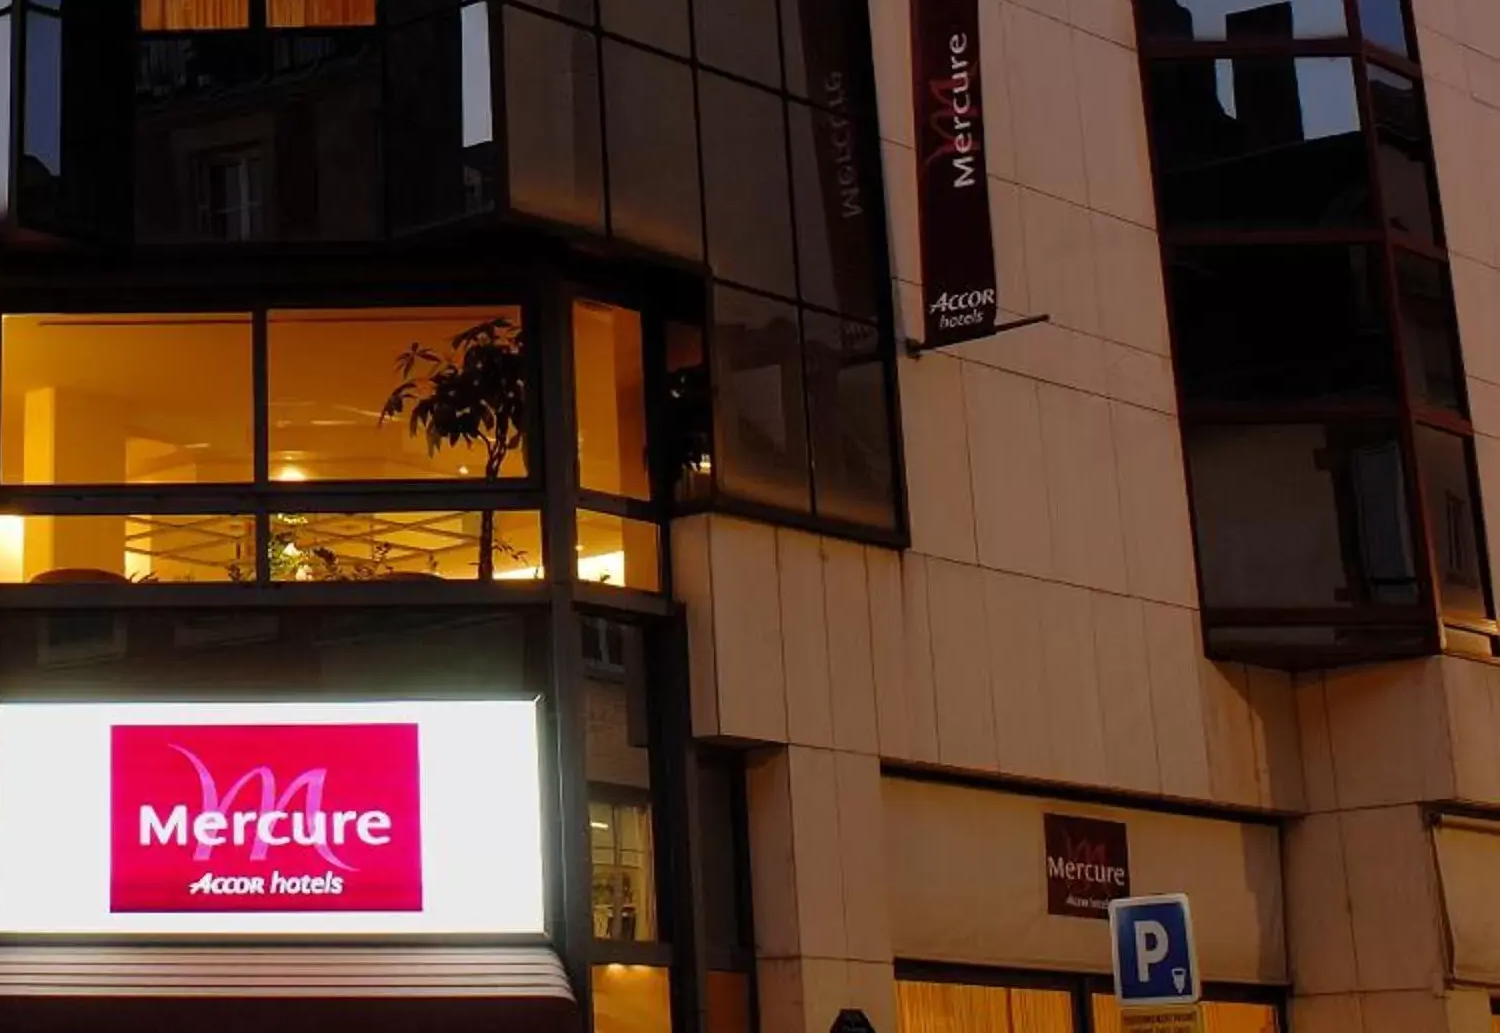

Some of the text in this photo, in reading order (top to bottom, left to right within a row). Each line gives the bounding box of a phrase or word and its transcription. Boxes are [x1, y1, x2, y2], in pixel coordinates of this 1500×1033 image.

[949, 31, 977, 188] Mercure
[939, 307, 984, 329] hotels
[138, 804, 392, 847] Mercure
[269, 870, 344, 896] hotels
[1047, 856, 1126, 887] Mercure
[1133, 919, 1170, 984] P
